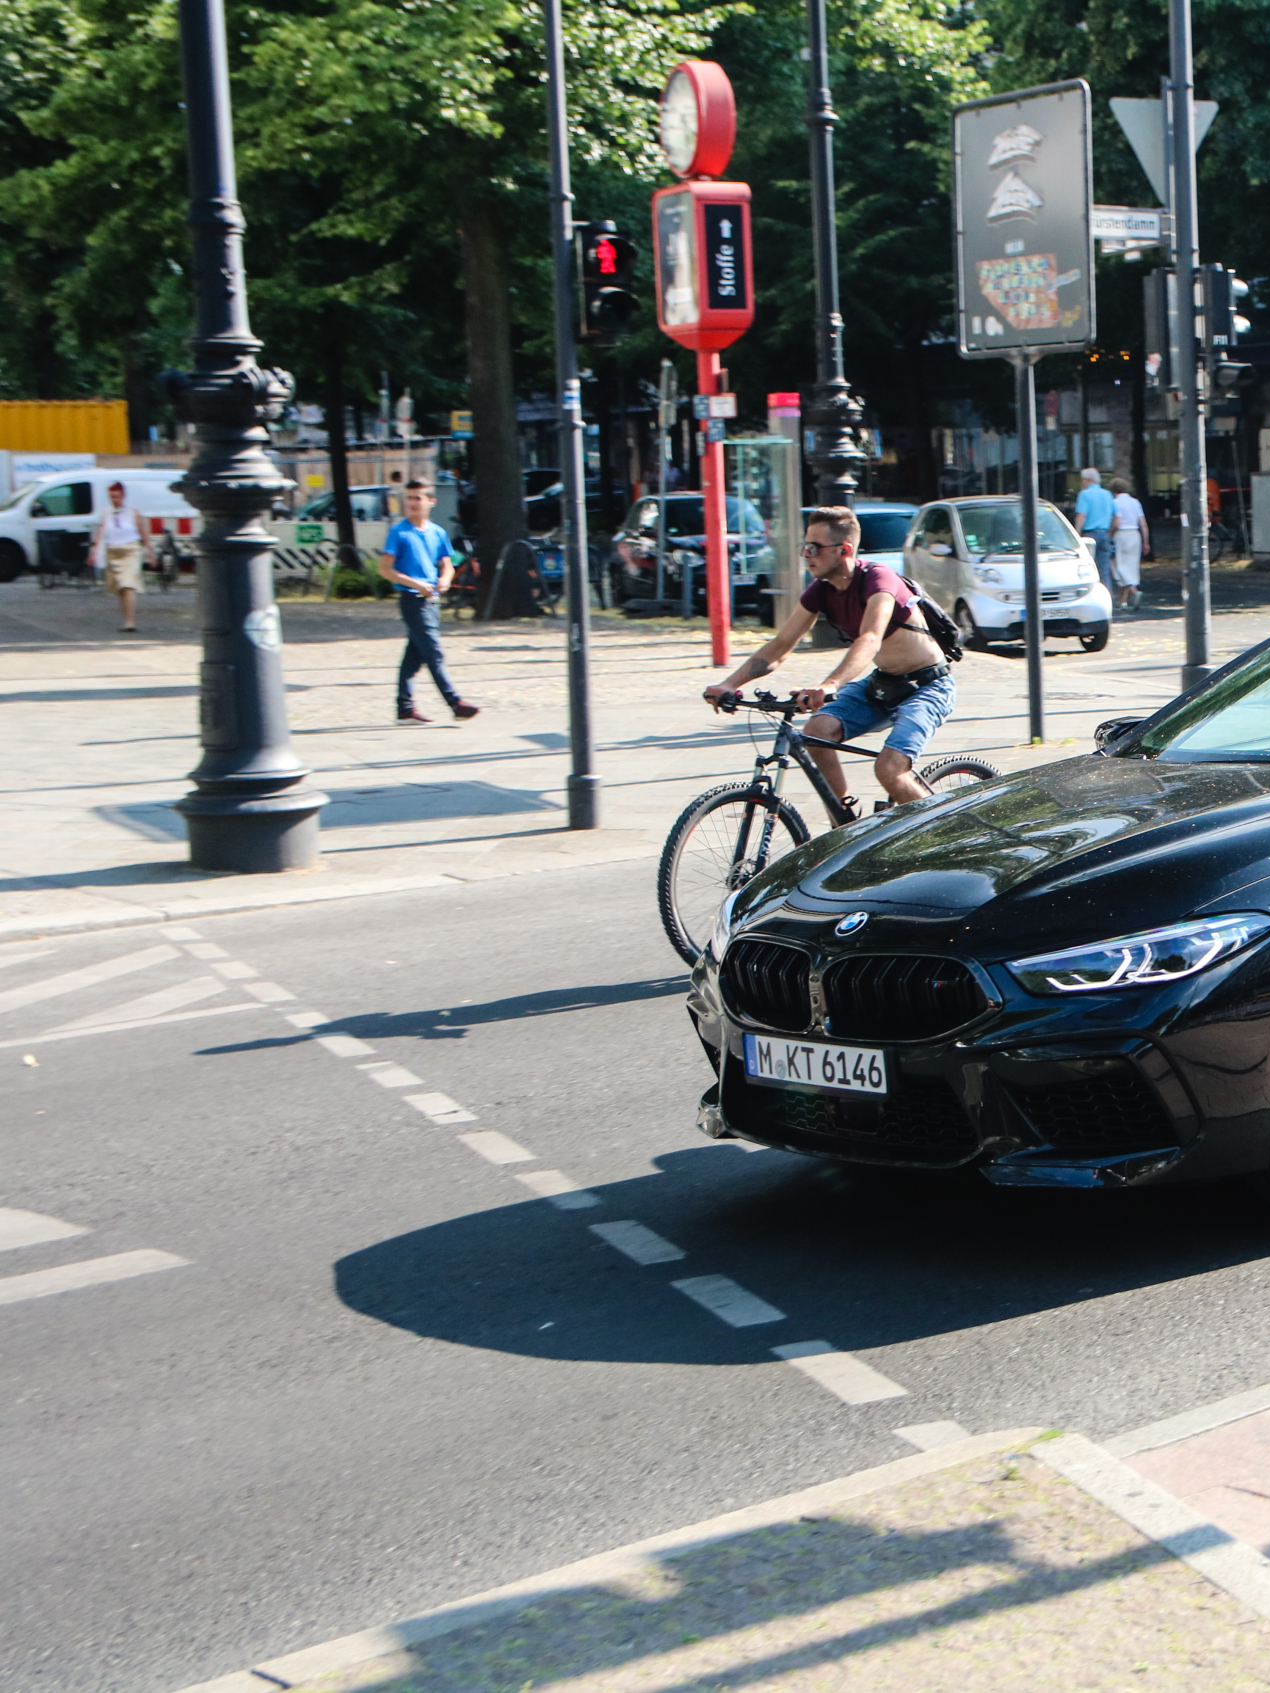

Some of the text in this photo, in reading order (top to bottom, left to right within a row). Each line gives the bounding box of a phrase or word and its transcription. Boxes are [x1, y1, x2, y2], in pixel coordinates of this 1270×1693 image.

[715, 244, 736, 296] Stoffe
[758, 1040, 773, 1075] M
[786, 1044, 815, 1081] KT
[822, 1049, 883, 1089] 6146
